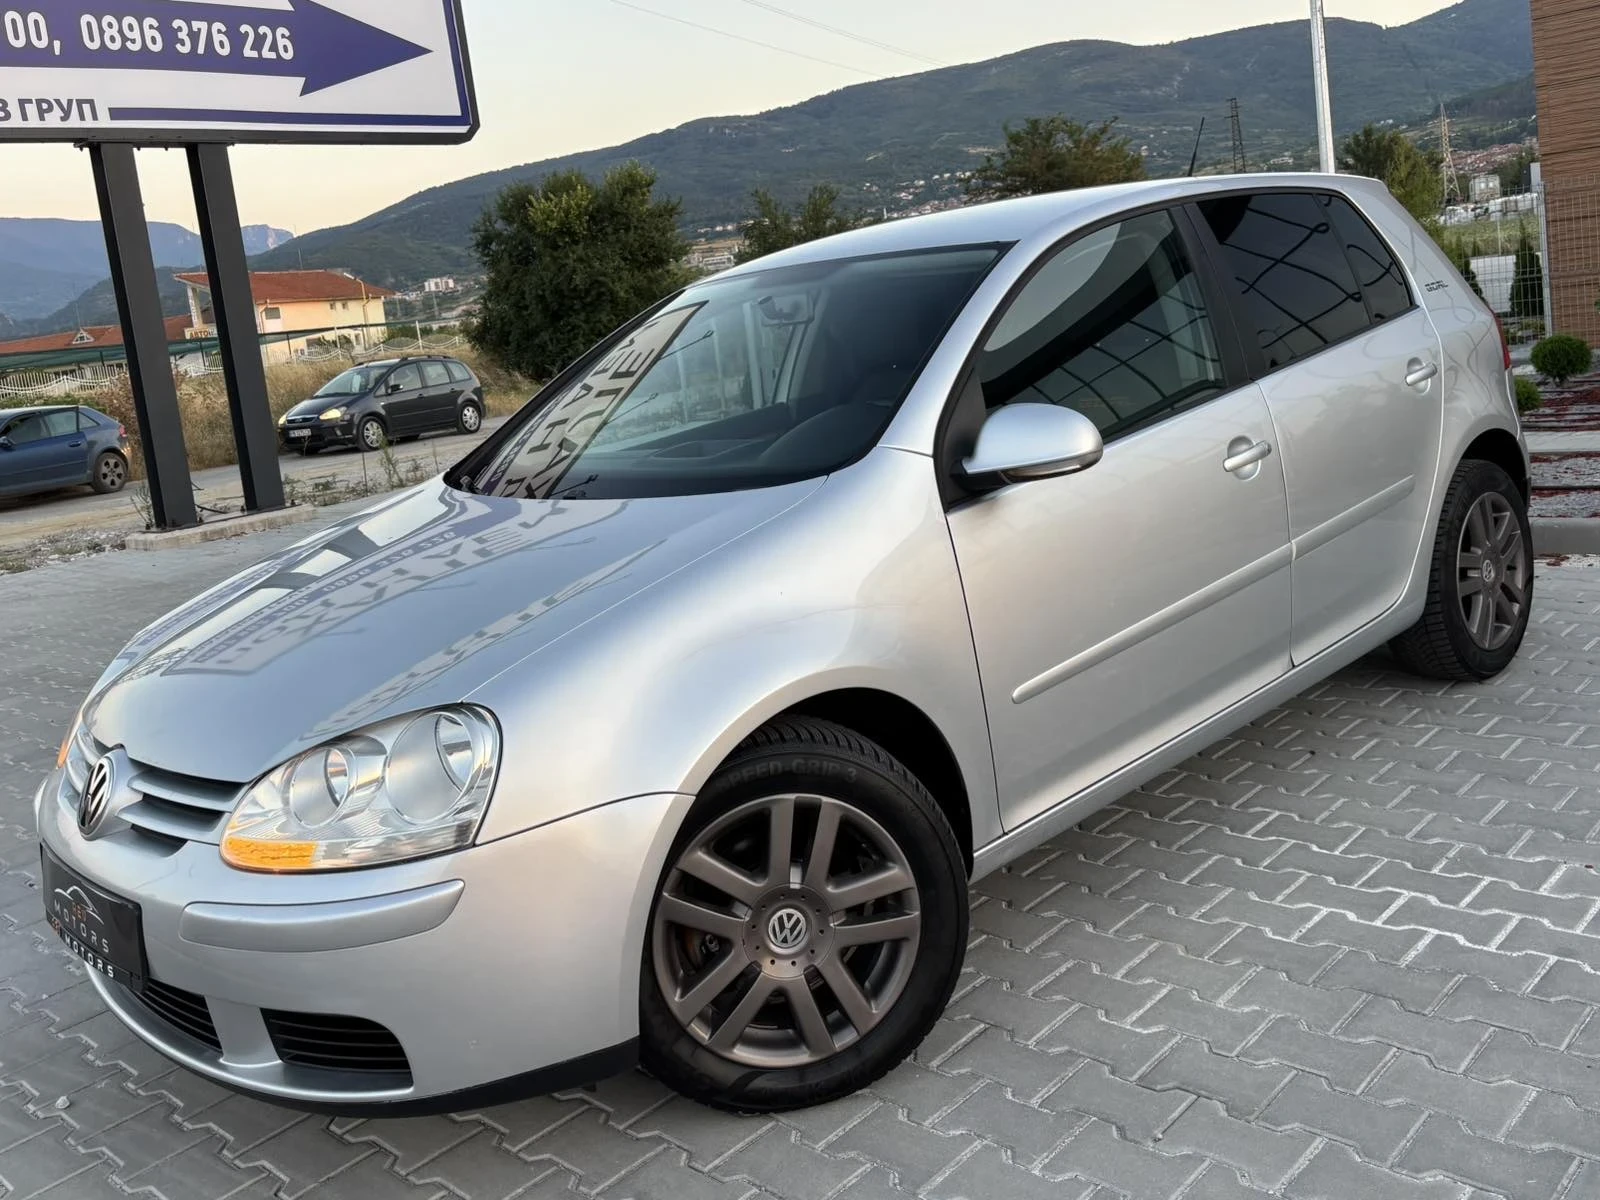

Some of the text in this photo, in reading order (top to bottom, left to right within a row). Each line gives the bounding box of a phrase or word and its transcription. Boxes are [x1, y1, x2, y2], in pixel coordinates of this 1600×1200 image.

[80, 14, 163, 52] 0896
[172, 19, 231, 57] 376
[239, 24, 294, 60] 226
[17, 98, 99, 122] ГРУП
[54, 899, 110, 954] MOTORS
[64, 933, 115, 979] MOTORS
